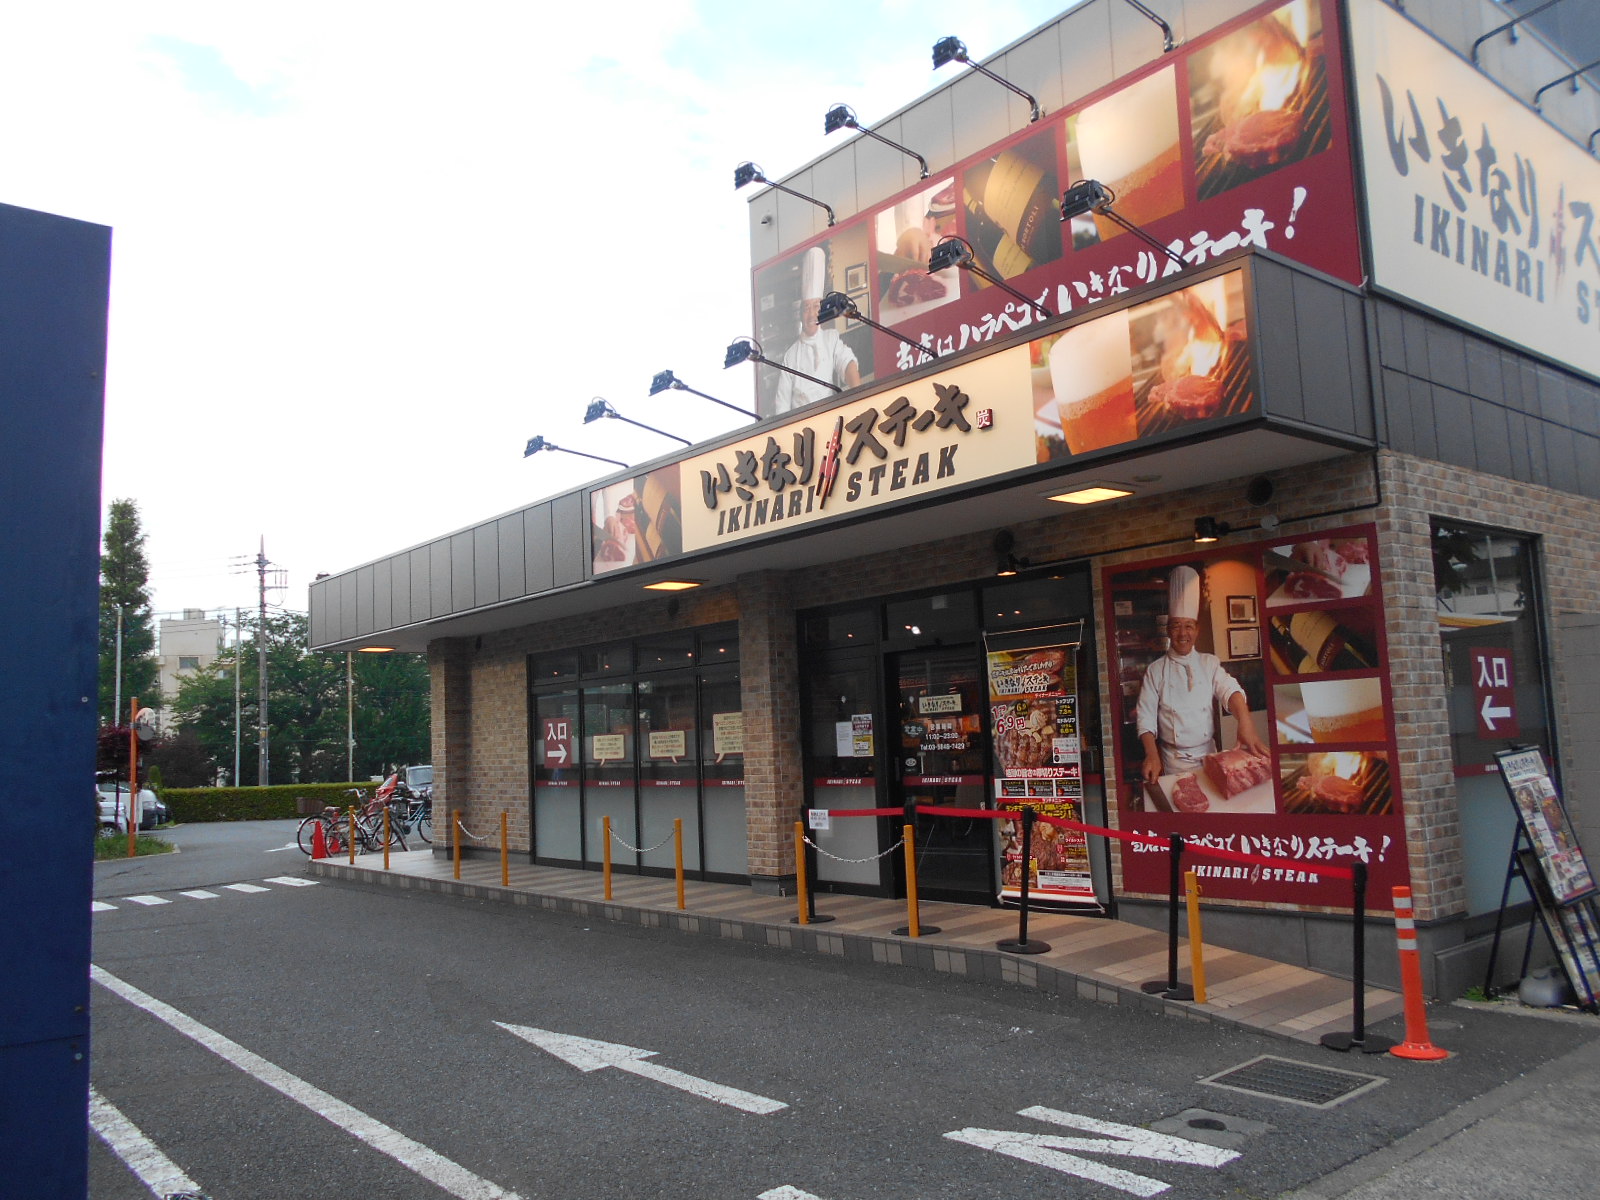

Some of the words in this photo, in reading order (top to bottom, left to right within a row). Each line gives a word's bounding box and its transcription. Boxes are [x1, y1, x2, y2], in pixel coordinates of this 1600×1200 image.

[1376, 72, 1540, 249] いきなり
[1413, 193, 1545, 303] IKINARI
[700, 427, 815, 509] いきなり
[845, 382, 971, 465] ステーキ
[717, 485, 816, 536] IKINARI
[846, 443, 959, 503] STEAK
[1026, 674, 1049, 686] ステーキ
[1477, 656, 1508, 688] 入口
[547, 722, 567, 740] 入口
[996, 716, 1026, 736] 6.9円
[1191, 865, 1249, 879] IKINARI
[1262, 867, 1319, 883] STEAK
